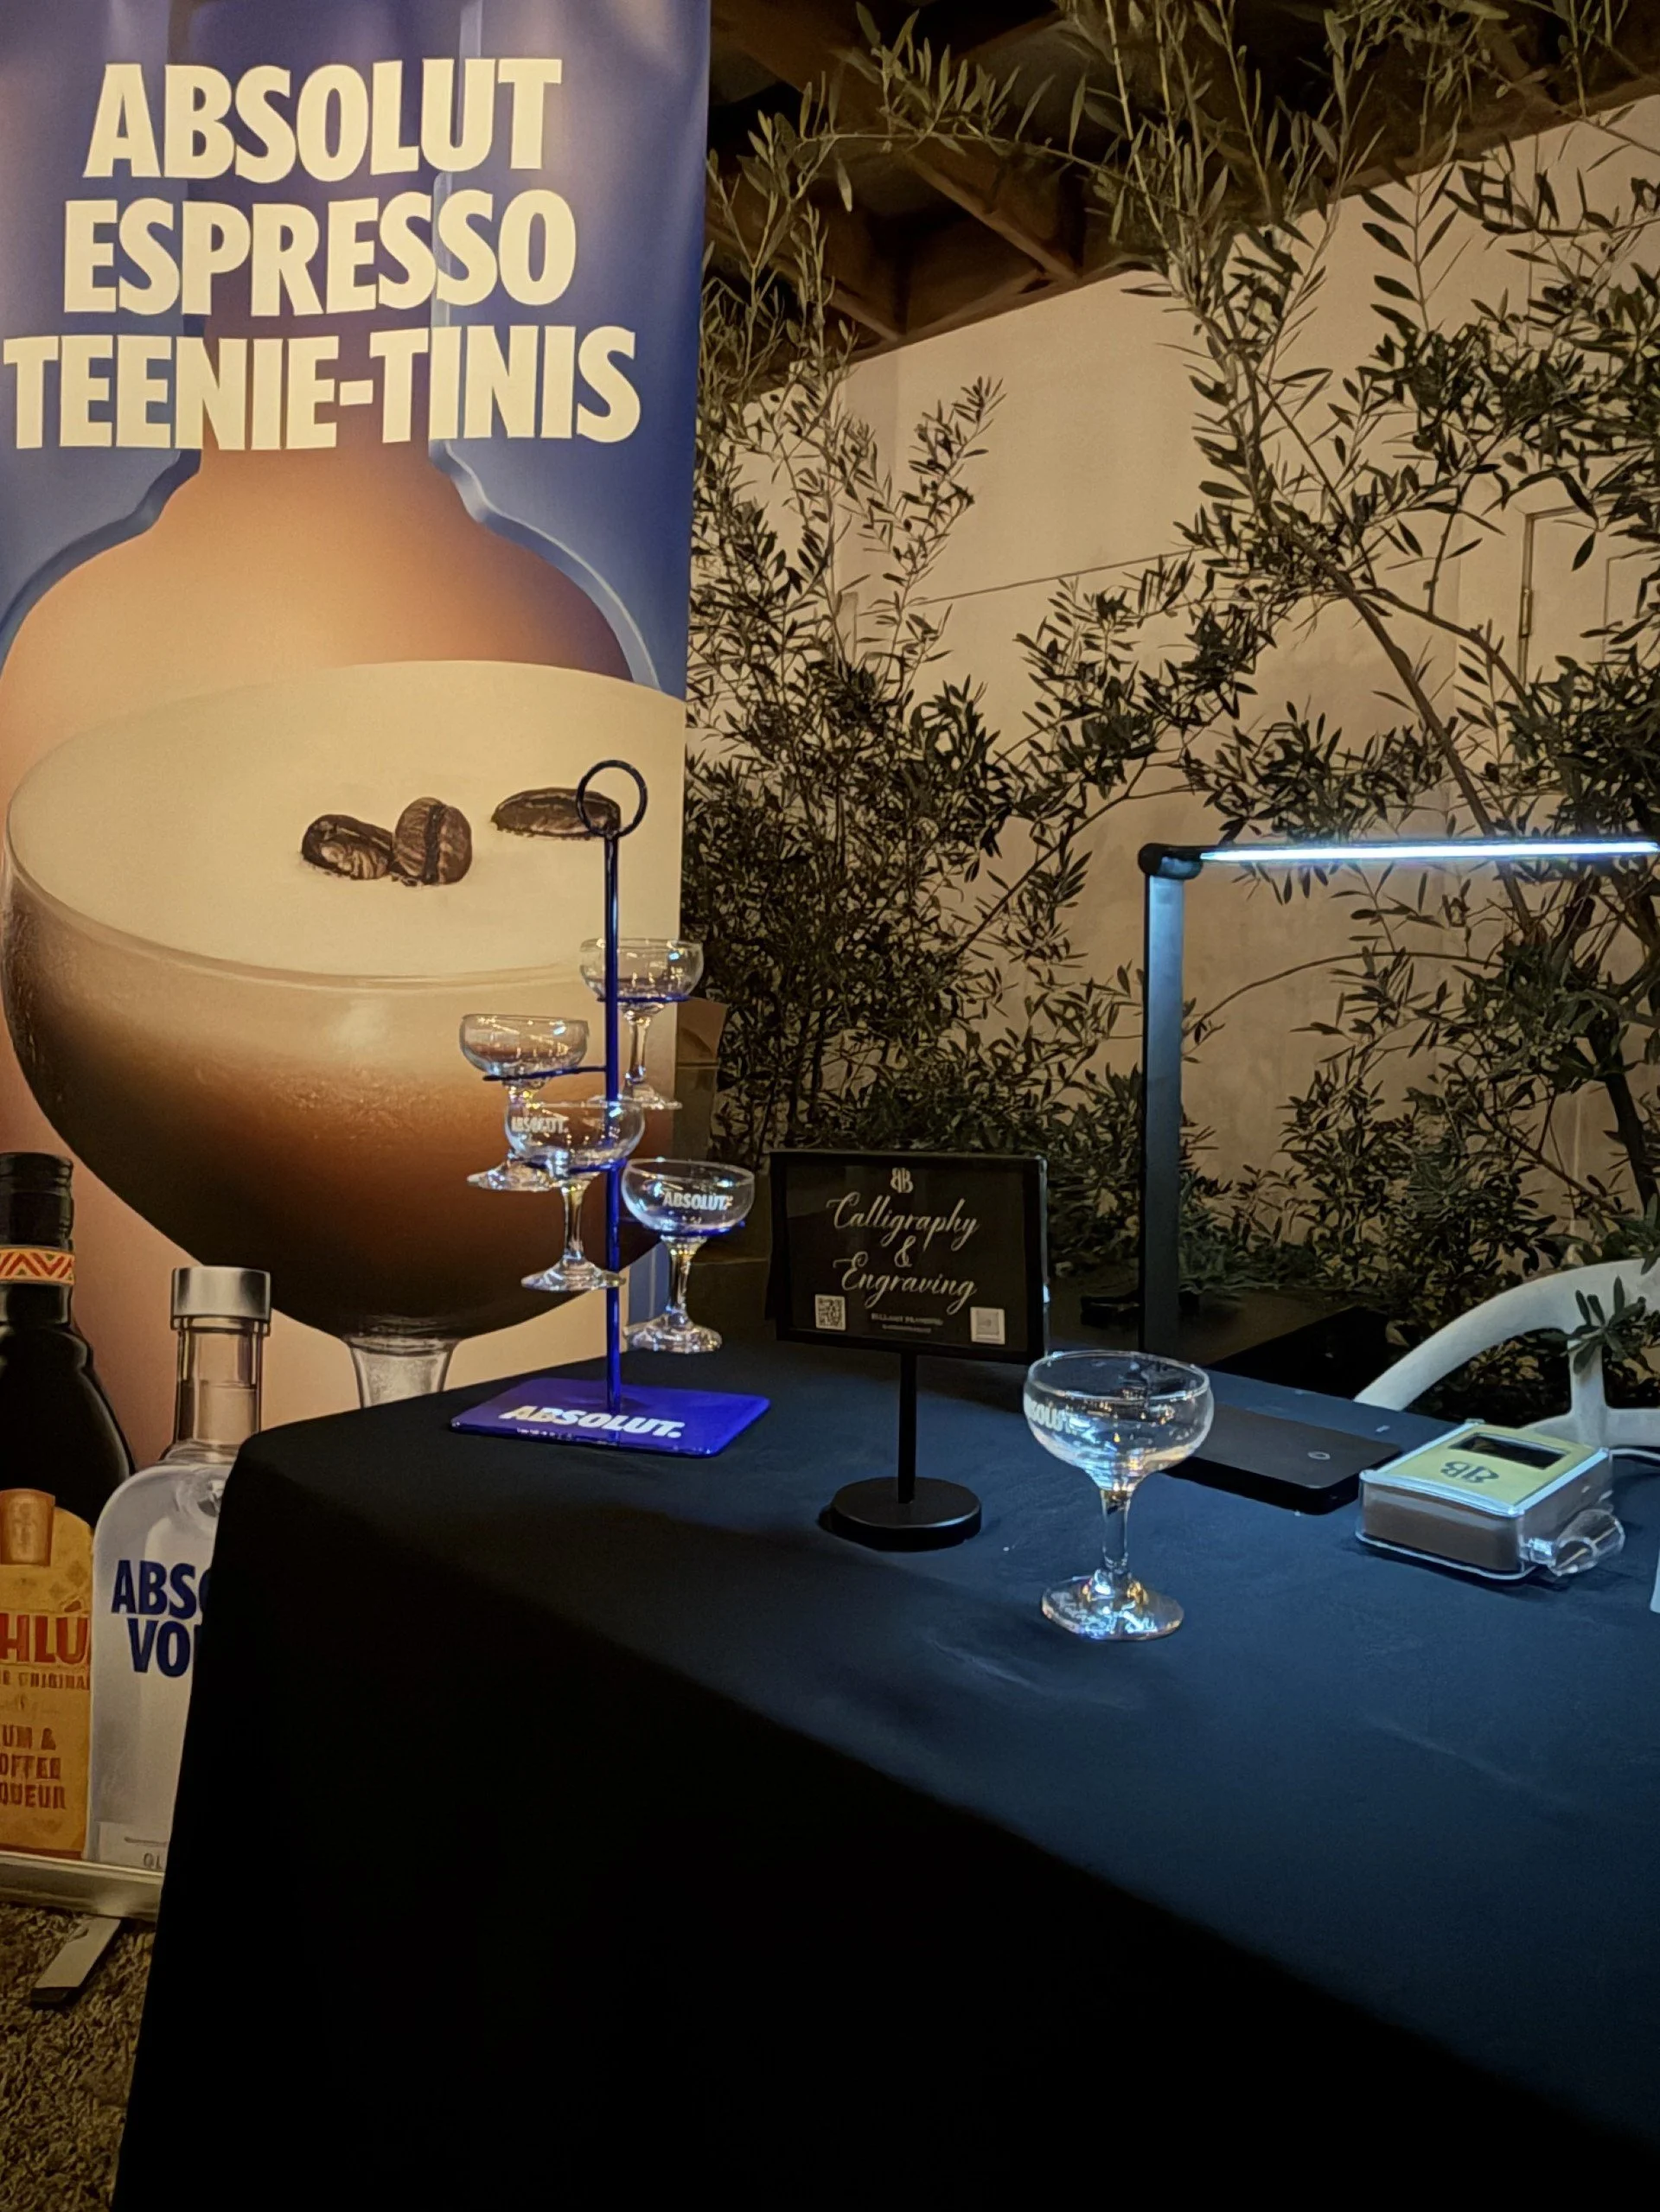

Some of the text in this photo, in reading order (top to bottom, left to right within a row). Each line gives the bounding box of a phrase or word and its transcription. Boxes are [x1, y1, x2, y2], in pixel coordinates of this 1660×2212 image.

[82, 58, 562, 184] ABSOLUT
[63, 189, 577, 317] ESPRESSO
[2, 325, 642, 451] TEENIE-TINIS
[826, 1191, 980, 1252] Calligraphy
[893, 1234, 917, 1268] &
[833, 1251, 978, 1315] Engraving
[0, 1600, 90, 1664] HLÚ
